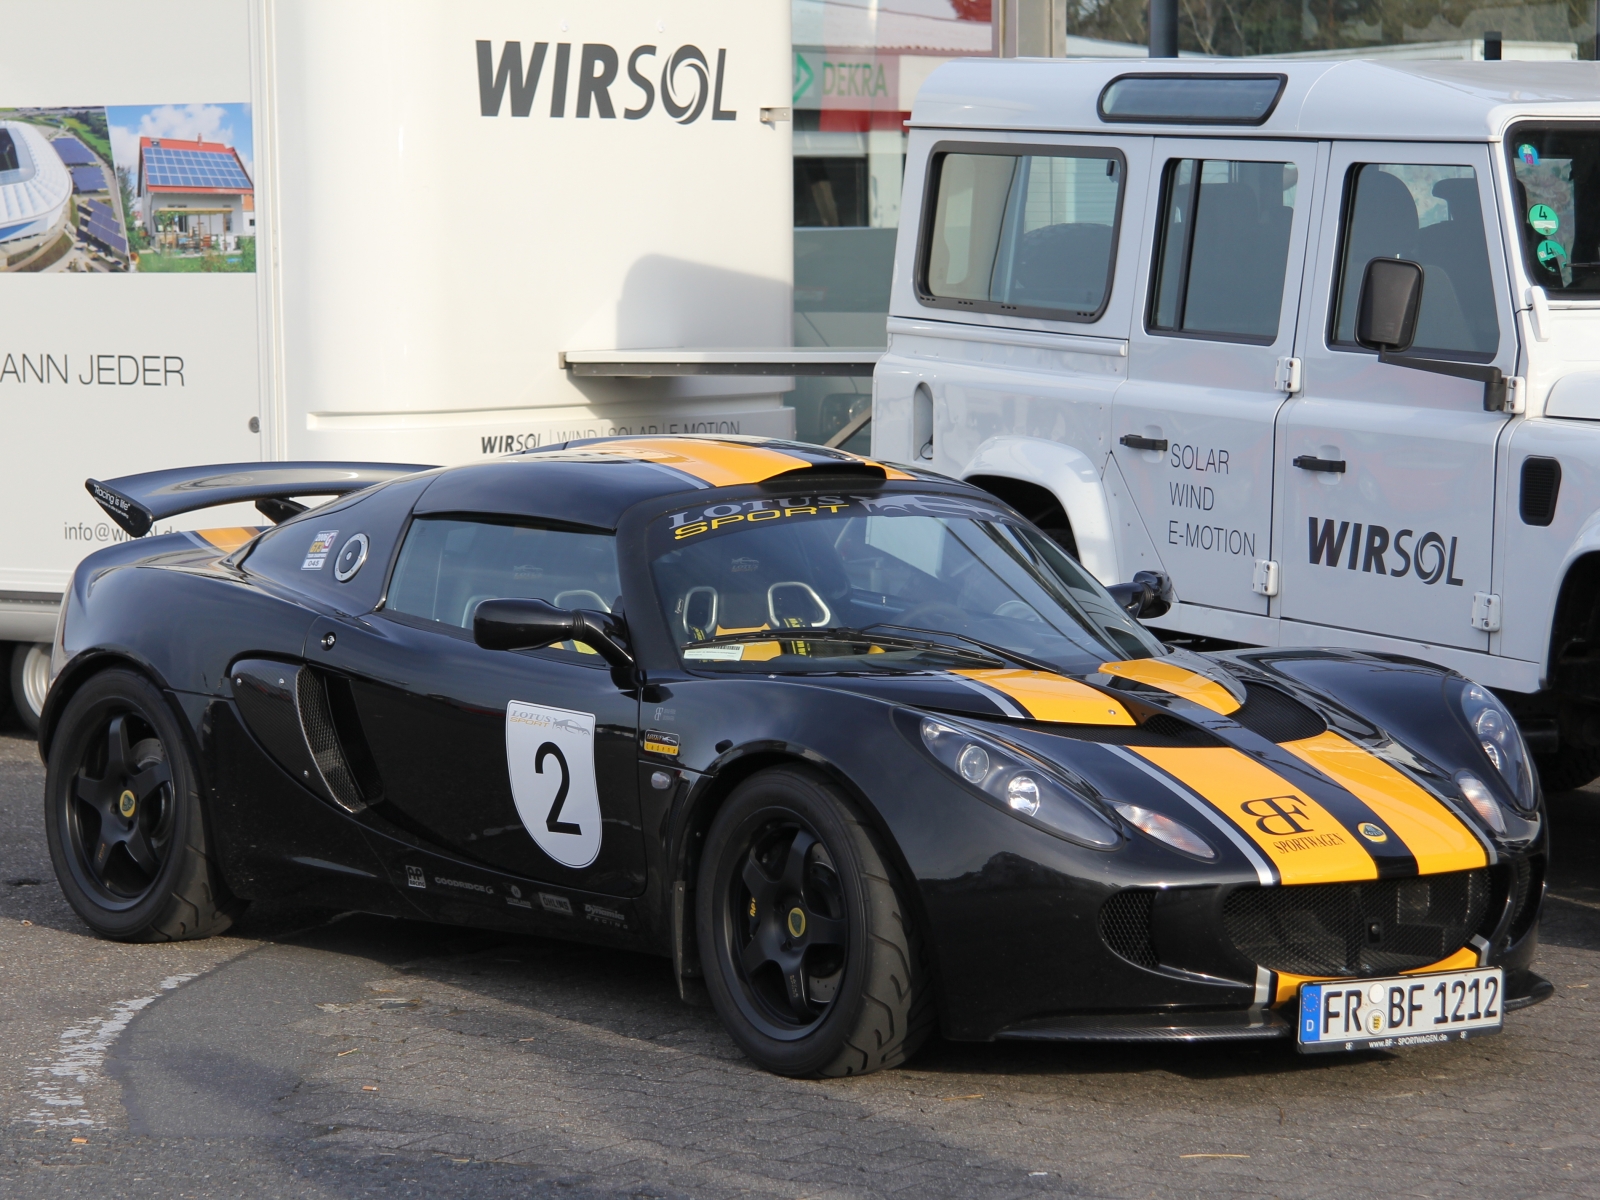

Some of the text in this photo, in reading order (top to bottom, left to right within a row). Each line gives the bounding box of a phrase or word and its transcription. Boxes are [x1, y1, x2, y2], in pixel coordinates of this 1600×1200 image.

[475, 40, 737, 125] WIRSOL
[823, 61, 888, 97] DEKRA
[1538, 205, 1547, 220] 4
[1545, 242, 1554, 256] 4
[0, 353, 185, 387] ANN JEDER
[480, 433, 541, 454] WIRSOL
[1170, 443, 1230, 475] SOLAR
[1169, 481, 1215, 511] WIND
[668, 495, 845, 530] LOTUS
[674, 504, 850, 540] SPORT
[1168, 520, 1256, 557] E-MOTION
[1308, 516, 1464, 586] WIRSOL
[509, 716, 551, 728] SPORT
[510, 709, 552, 723] LOTUS
[534, 741, 582, 836] 2
[1273, 832, 1347, 855] SPORTWAGEN
[434, 876, 486, 893] GOODRIDGE
[584, 904, 625, 921] Dynamics
[586, 915, 628, 930] RACING
[1322, 976, 1499, 1034] FR BF 1212
[1306, 1019, 1315, 1032] D
